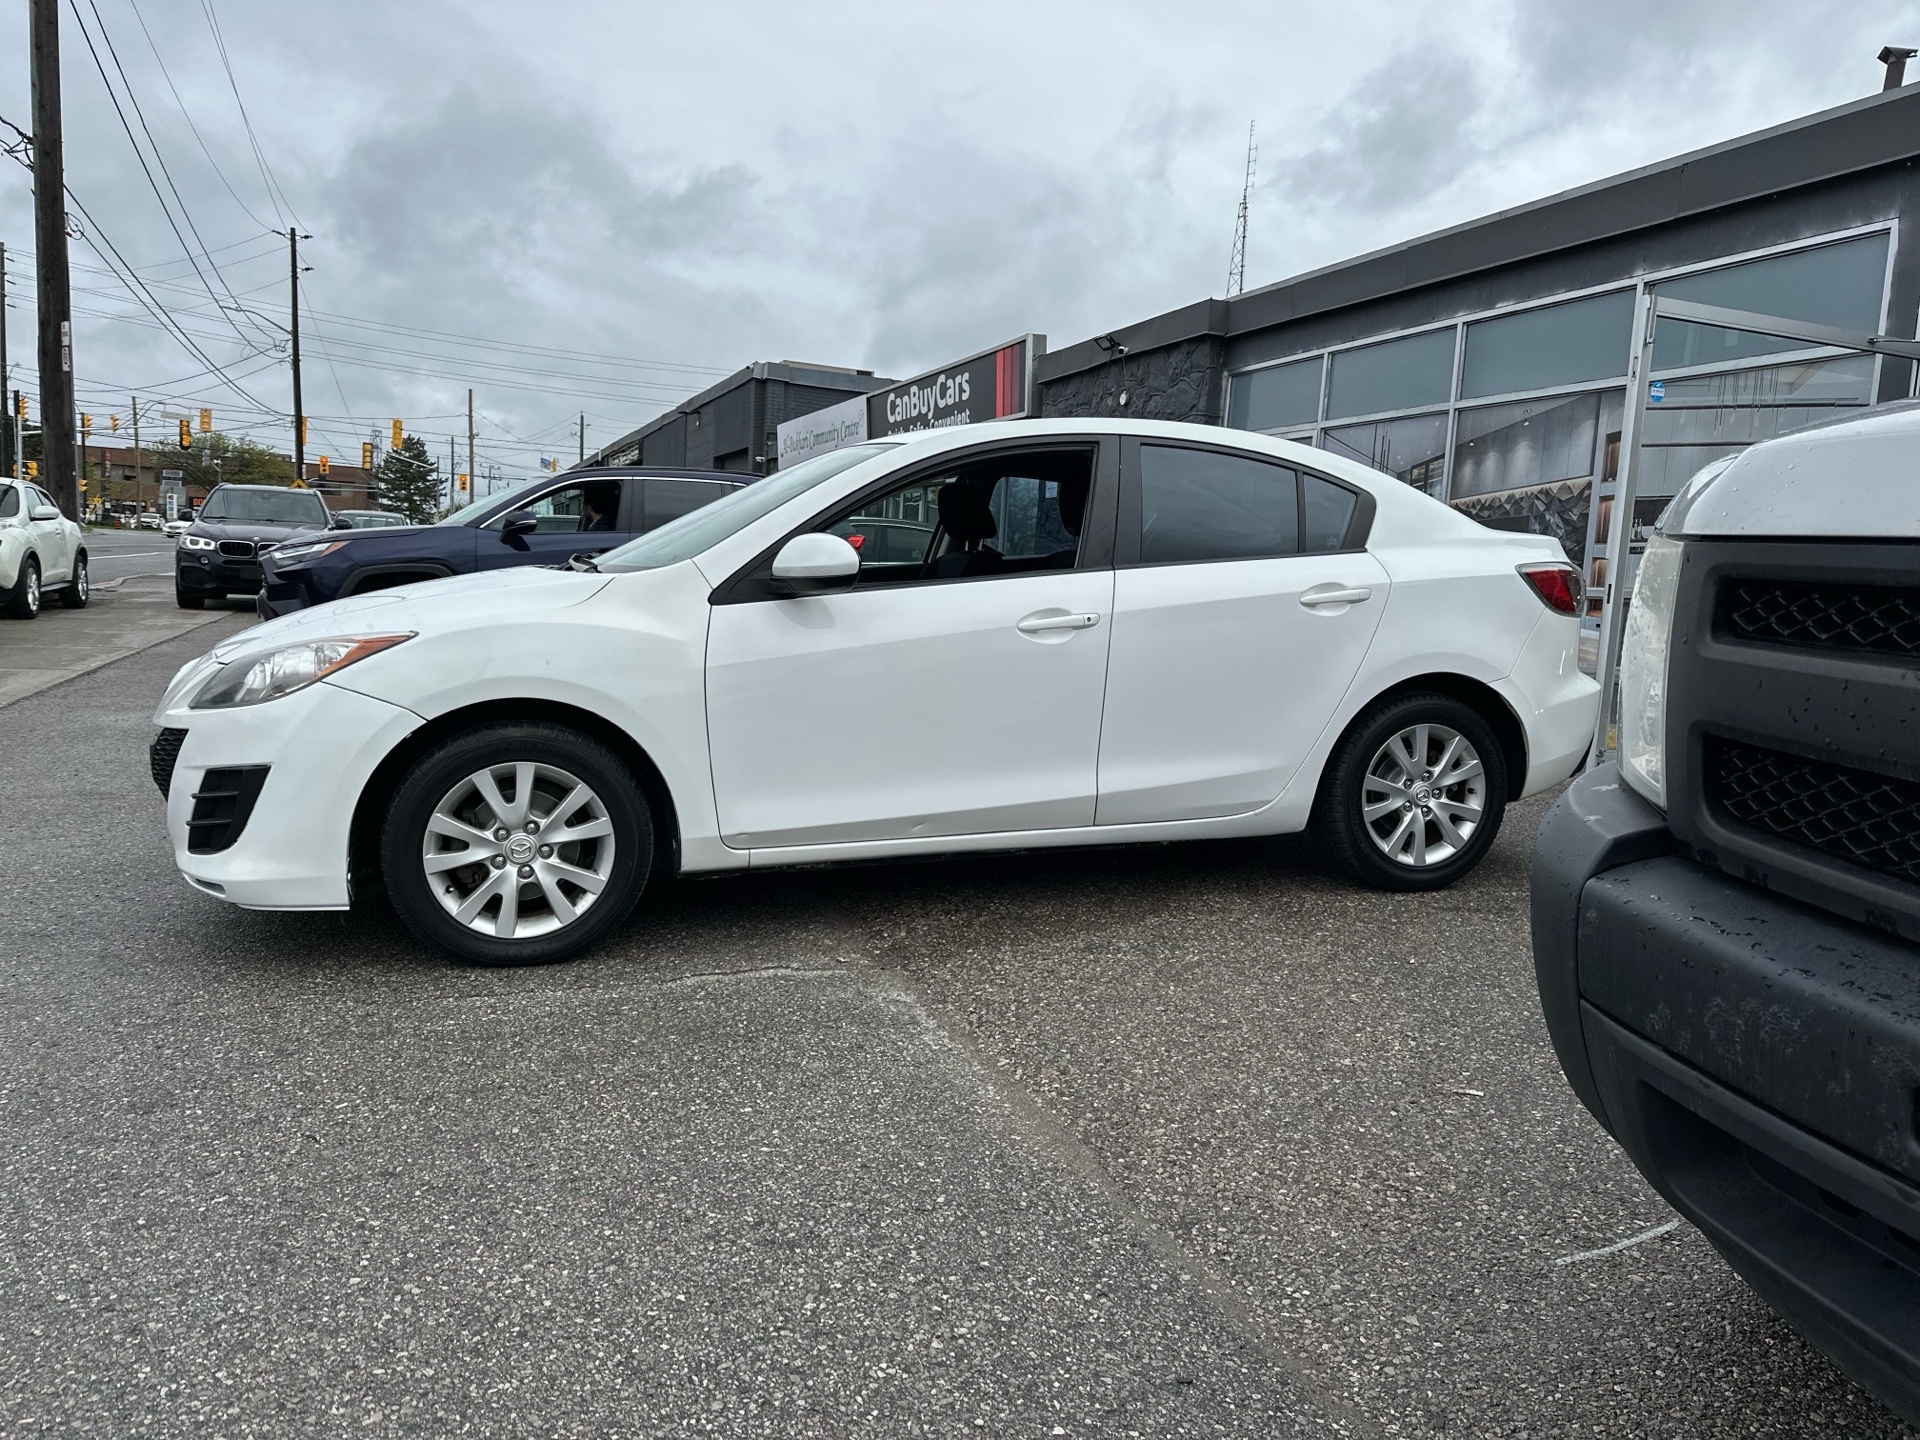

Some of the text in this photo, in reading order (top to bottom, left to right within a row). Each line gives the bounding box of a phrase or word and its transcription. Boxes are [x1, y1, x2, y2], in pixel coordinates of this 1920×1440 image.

[887, 372, 970, 423] CanBuyCars
[809, 423, 840, 448] Community
[840, 420, 860, 442] Centre
